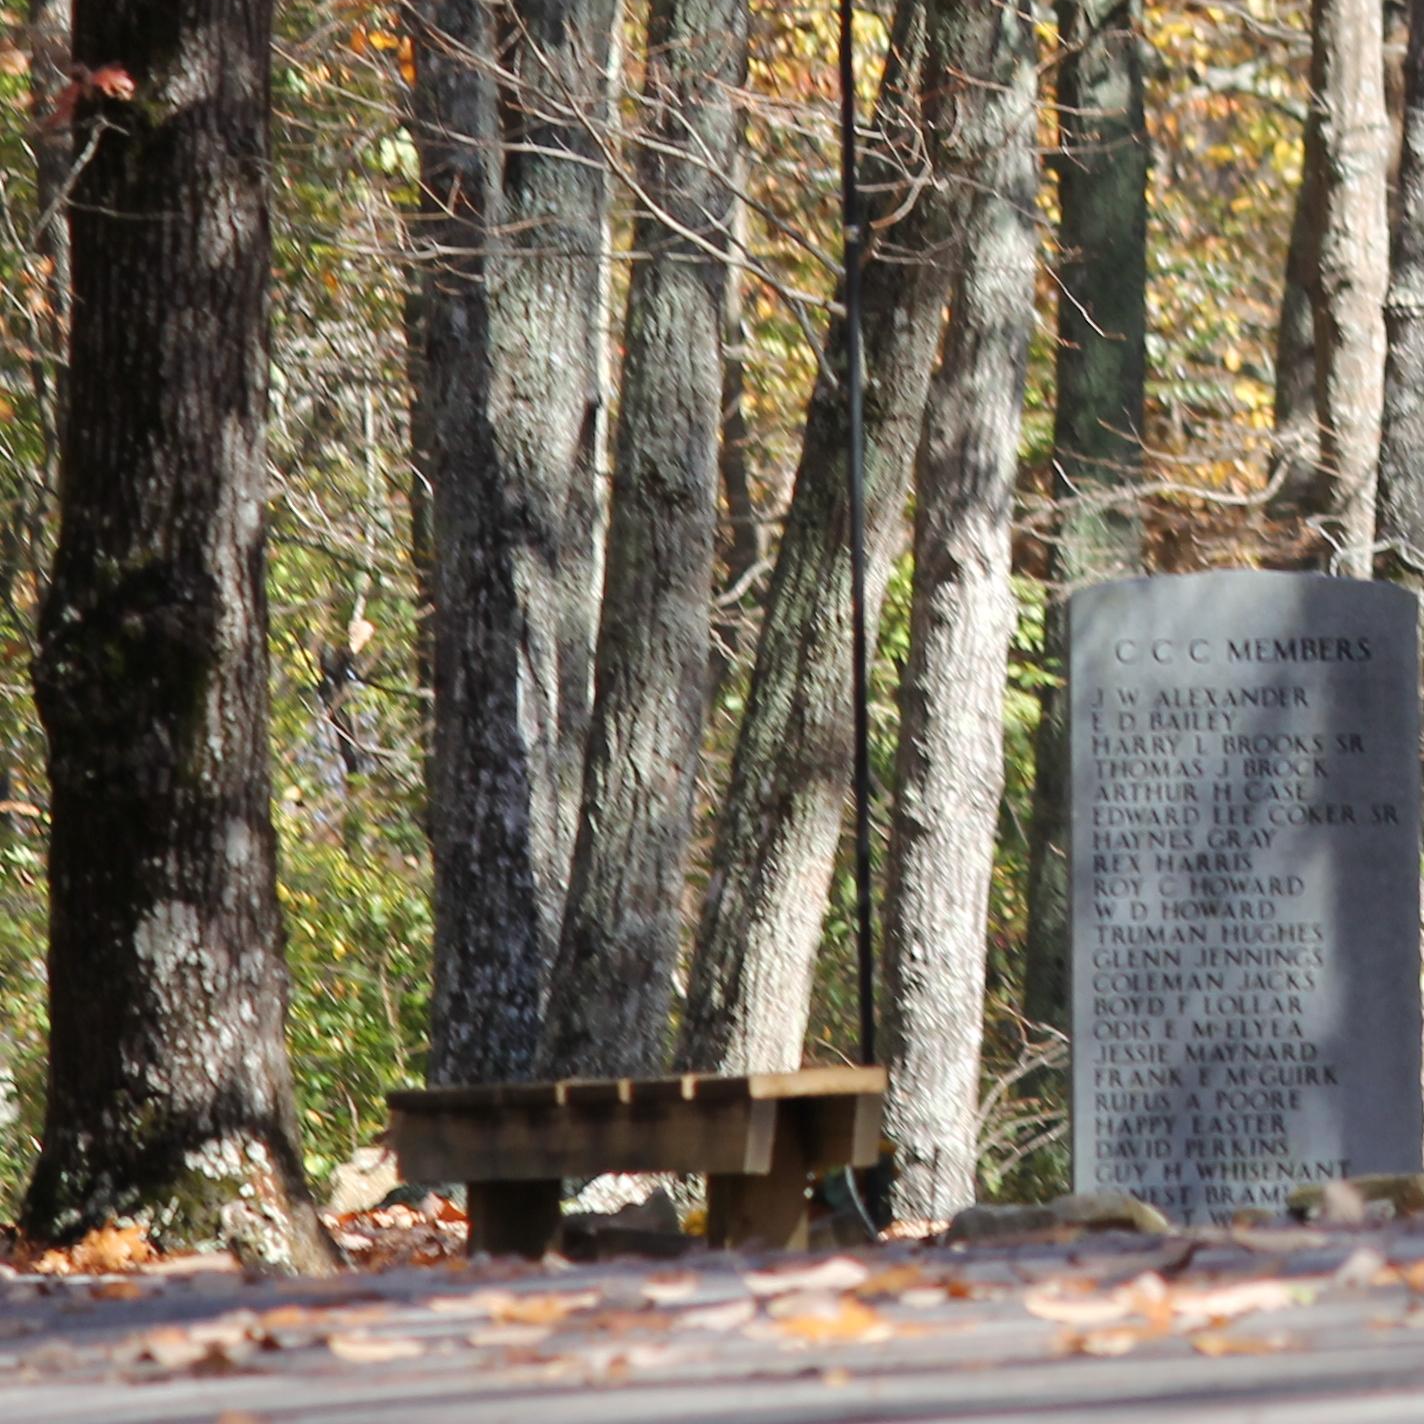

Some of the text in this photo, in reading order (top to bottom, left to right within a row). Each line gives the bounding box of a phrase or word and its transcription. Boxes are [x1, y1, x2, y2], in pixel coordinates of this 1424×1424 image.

[1227, 636, 1372, 663] MEMBERS
[1092, 686, 1310, 708] J W ALEXANDER
[1119, 711, 1136, 731] D
[1150, 711, 1235, 731] BAILEY
[1092, 733, 1365, 756] HARRY L BROOKS SR
[1095, 758, 1329, 779] THOMAS J BROCK
[1096, 781, 1309, 803] ARTHUR H CASE
[1092, 803, 1399, 826] EDWARD LEE COKER SR
[1092, 828, 1278, 850] HAYNES GRAY
[1093, 853, 1254, 874] REX HARRIS
[1093, 876, 1305, 899] ROY C HOWARD
[1095, 899, 1276, 920] W D HOWARD
[1095, 925, 1325, 946] TRUMAN HUGHES
[1093, 947, 1325, 969] GLENN JENNINGS
[1093, 971, 1317, 994] COLEMAN JACKS
[1094, 996, 1166, 1017] BOYD
[1204, 995, 1304, 1016] LOLLAR
[1093, 1020, 1150, 1041] ODIS
[1095, 1042, 1318, 1065] JESSIE MAYNARD
[1094, 1068, 1184, 1089] FRANK
[1095, 1090, 1301, 1112] RUFUS A POORE
[1095, 1114, 1287, 1137] HAPPY EASTER
[1095, 1138, 1289, 1160] DAVID PERKINS
[1095, 1158, 1351, 1184] GUY H WHISENANT
